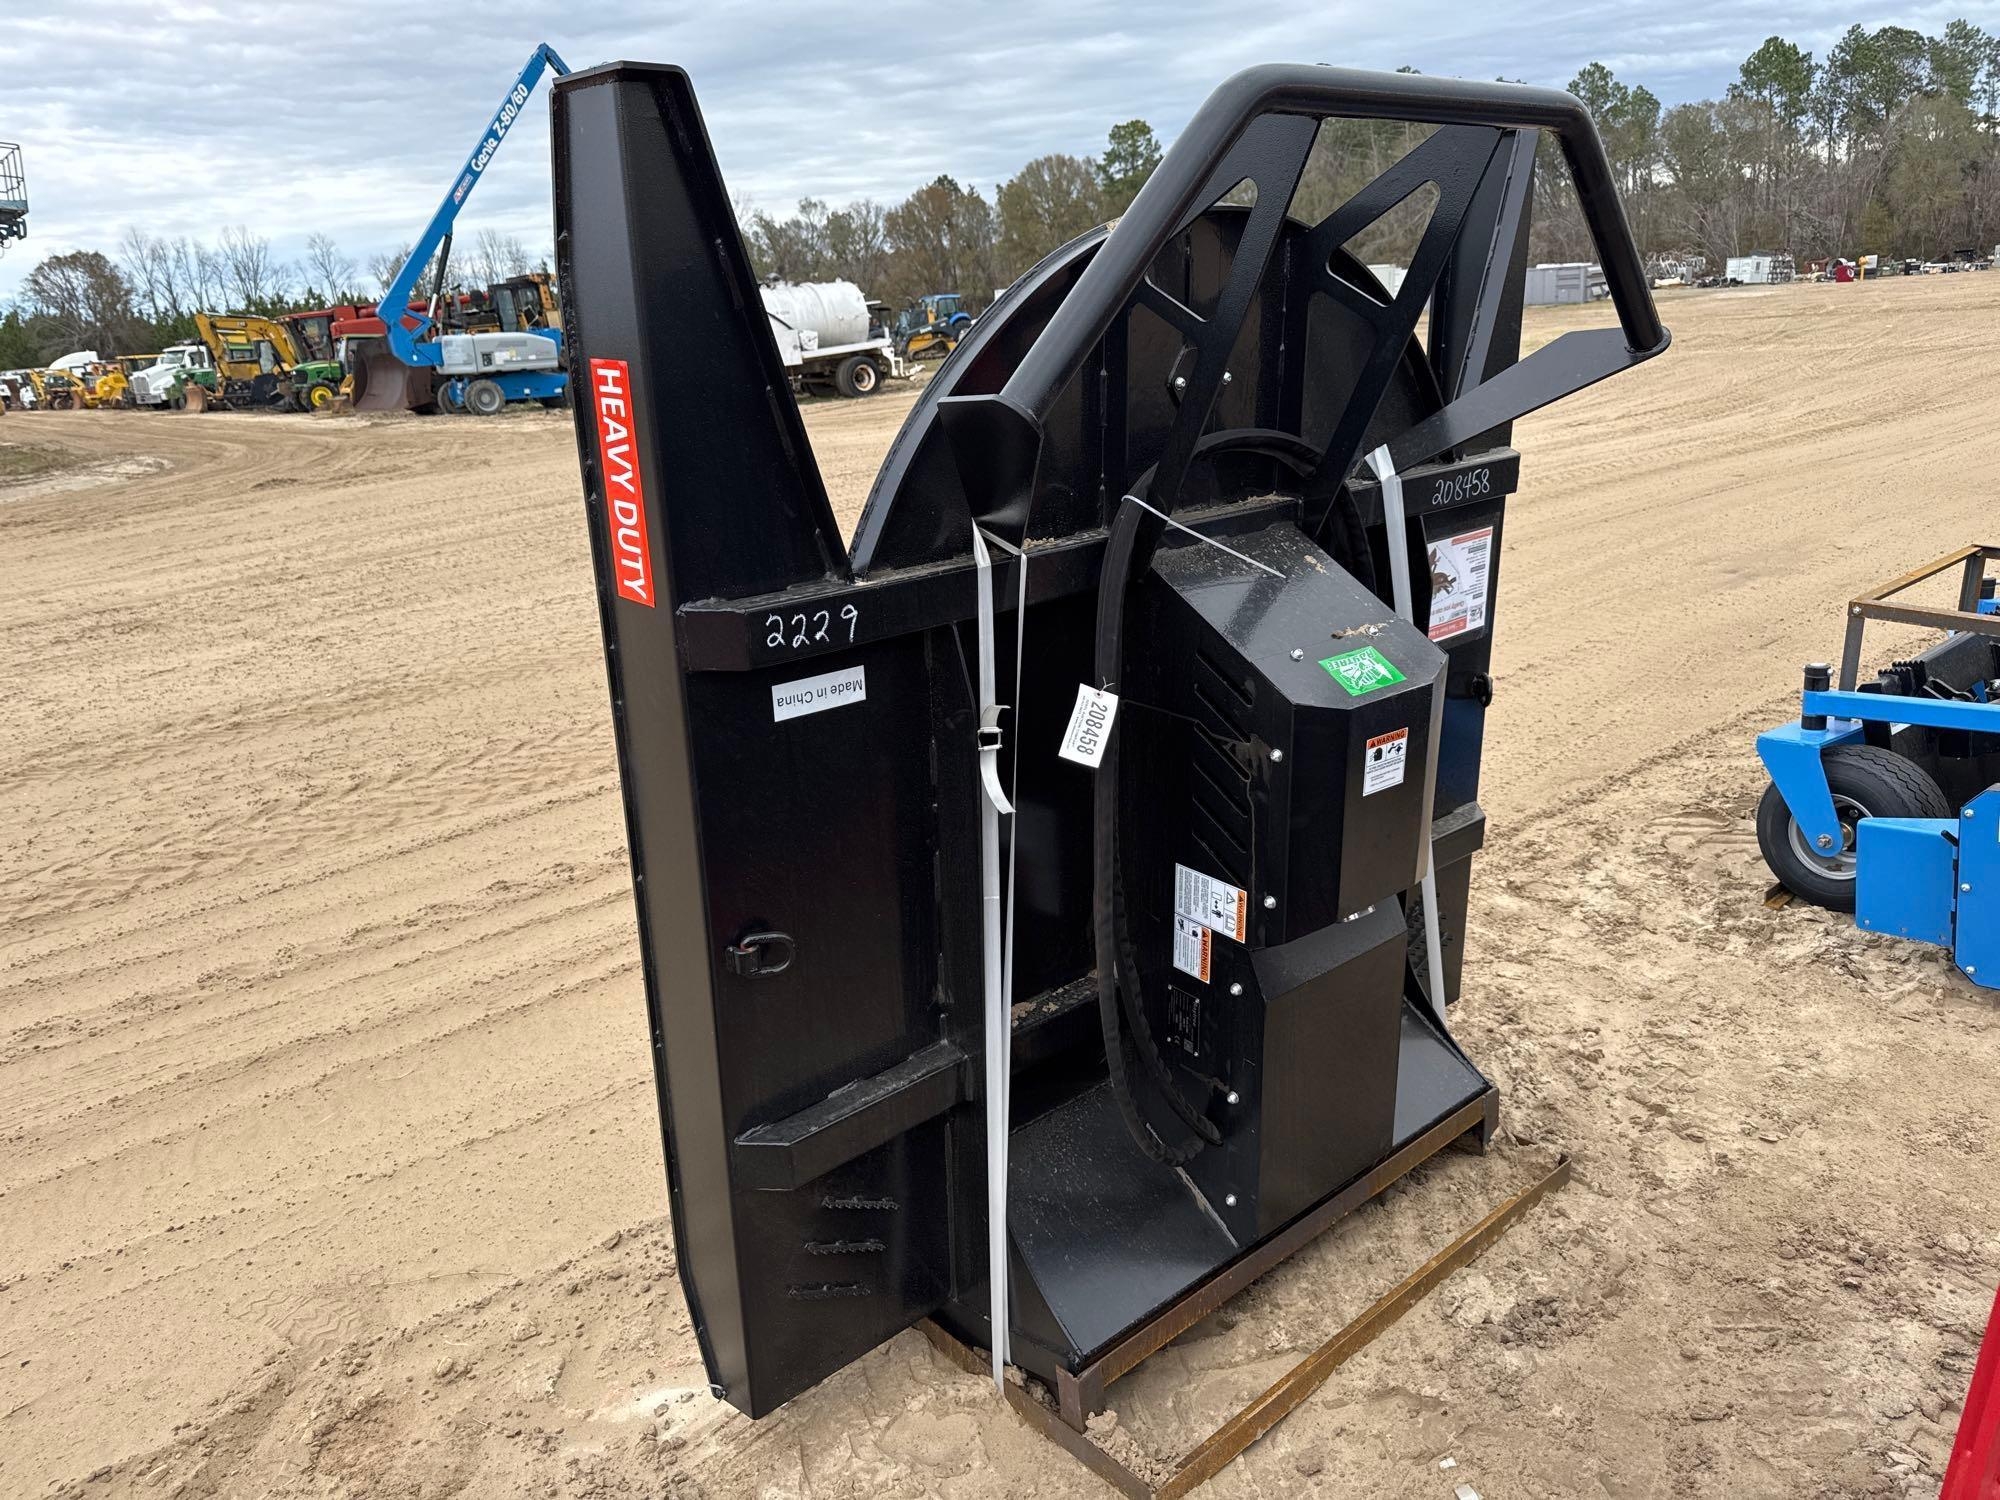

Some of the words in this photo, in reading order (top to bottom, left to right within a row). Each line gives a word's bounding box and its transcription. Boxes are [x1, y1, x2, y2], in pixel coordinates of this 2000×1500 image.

[470, 137, 498, 172] Genie
[492, 82, 528, 138] Z-80/60
[596, 367, 635, 493] HEAVY
[1432, 468, 1490, 505] 208458
[613, 499, 647, 599] DUTY
[765, 603, 859, 649] 2229
[777, 690, 814, 707] China
[817, 686, 828, 699] in
[830, 678, 863, 695] Made
[1076, 701, 1108, 756] 208458
[1376, 729, 1405, 745] WARNING
[1201, 938, 1209, 976] WARNING
